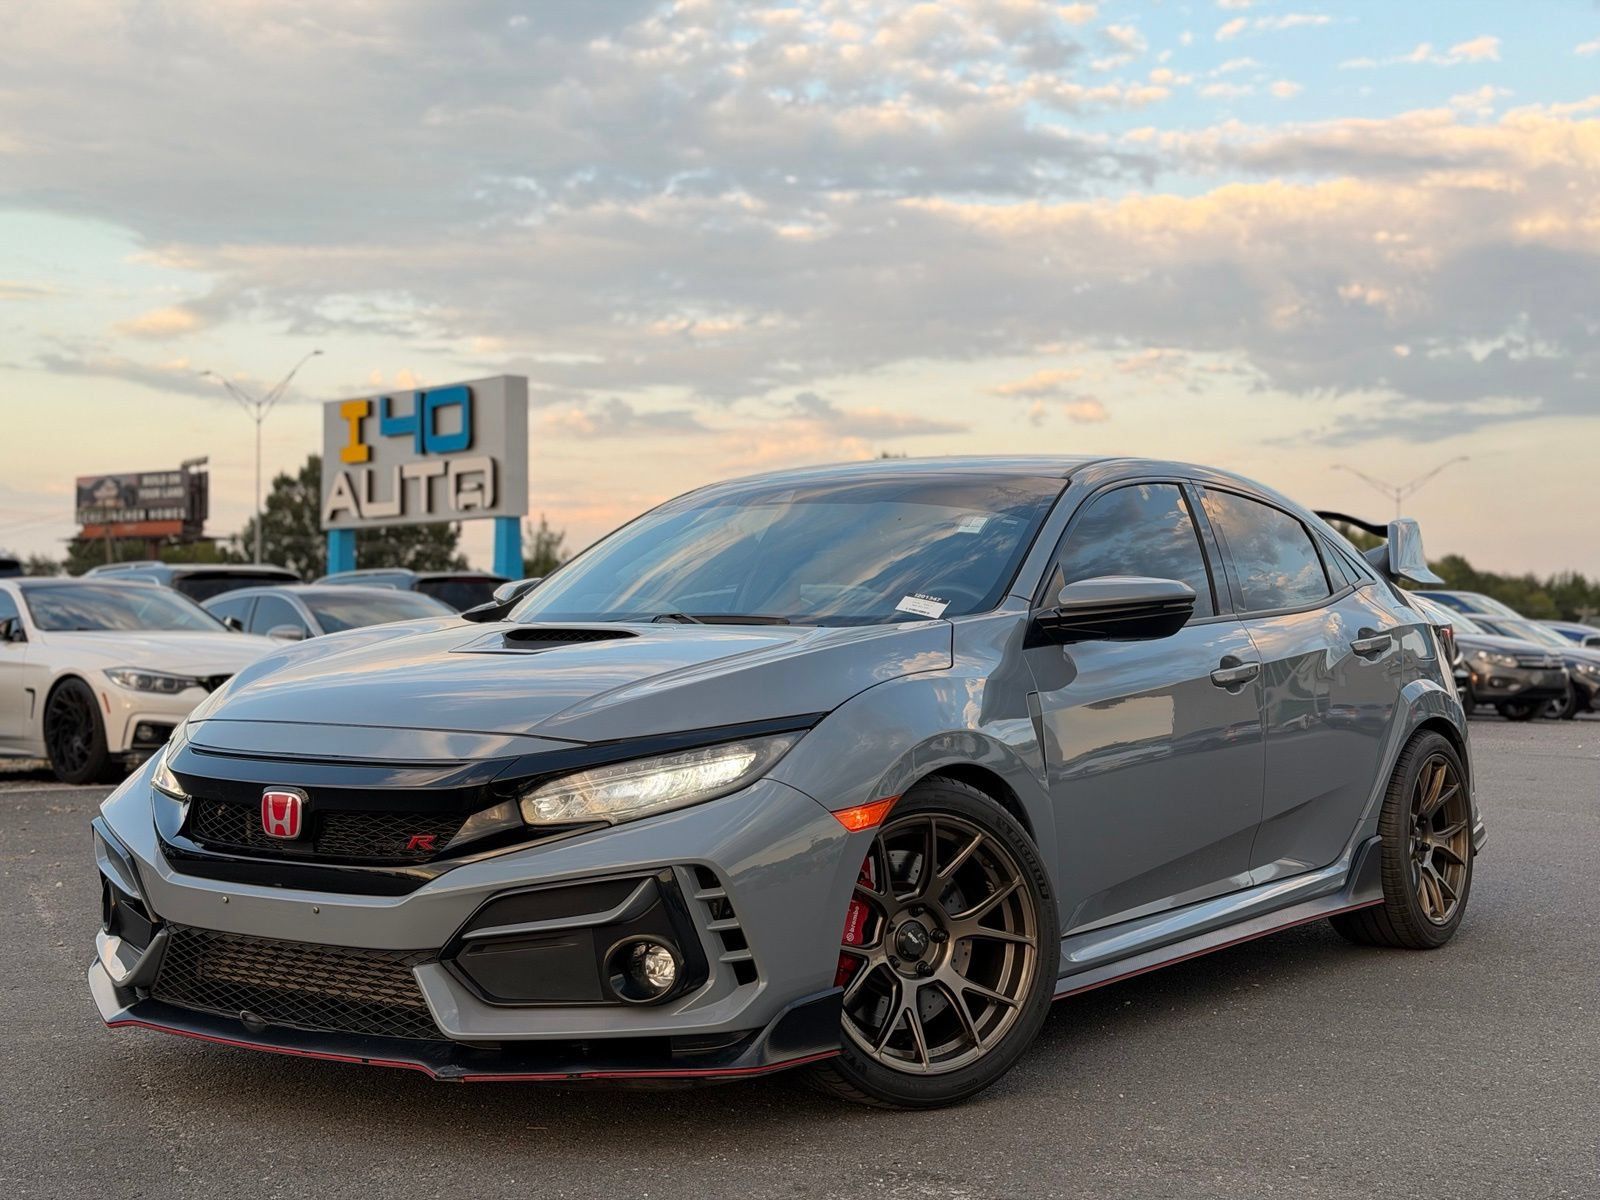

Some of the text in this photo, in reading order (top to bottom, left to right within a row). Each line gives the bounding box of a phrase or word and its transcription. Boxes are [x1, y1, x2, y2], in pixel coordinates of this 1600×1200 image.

[148, 507, 186, 520] HOMES
[407, 835, 435, 850] R
[849, 905, 859, 933] brembo
